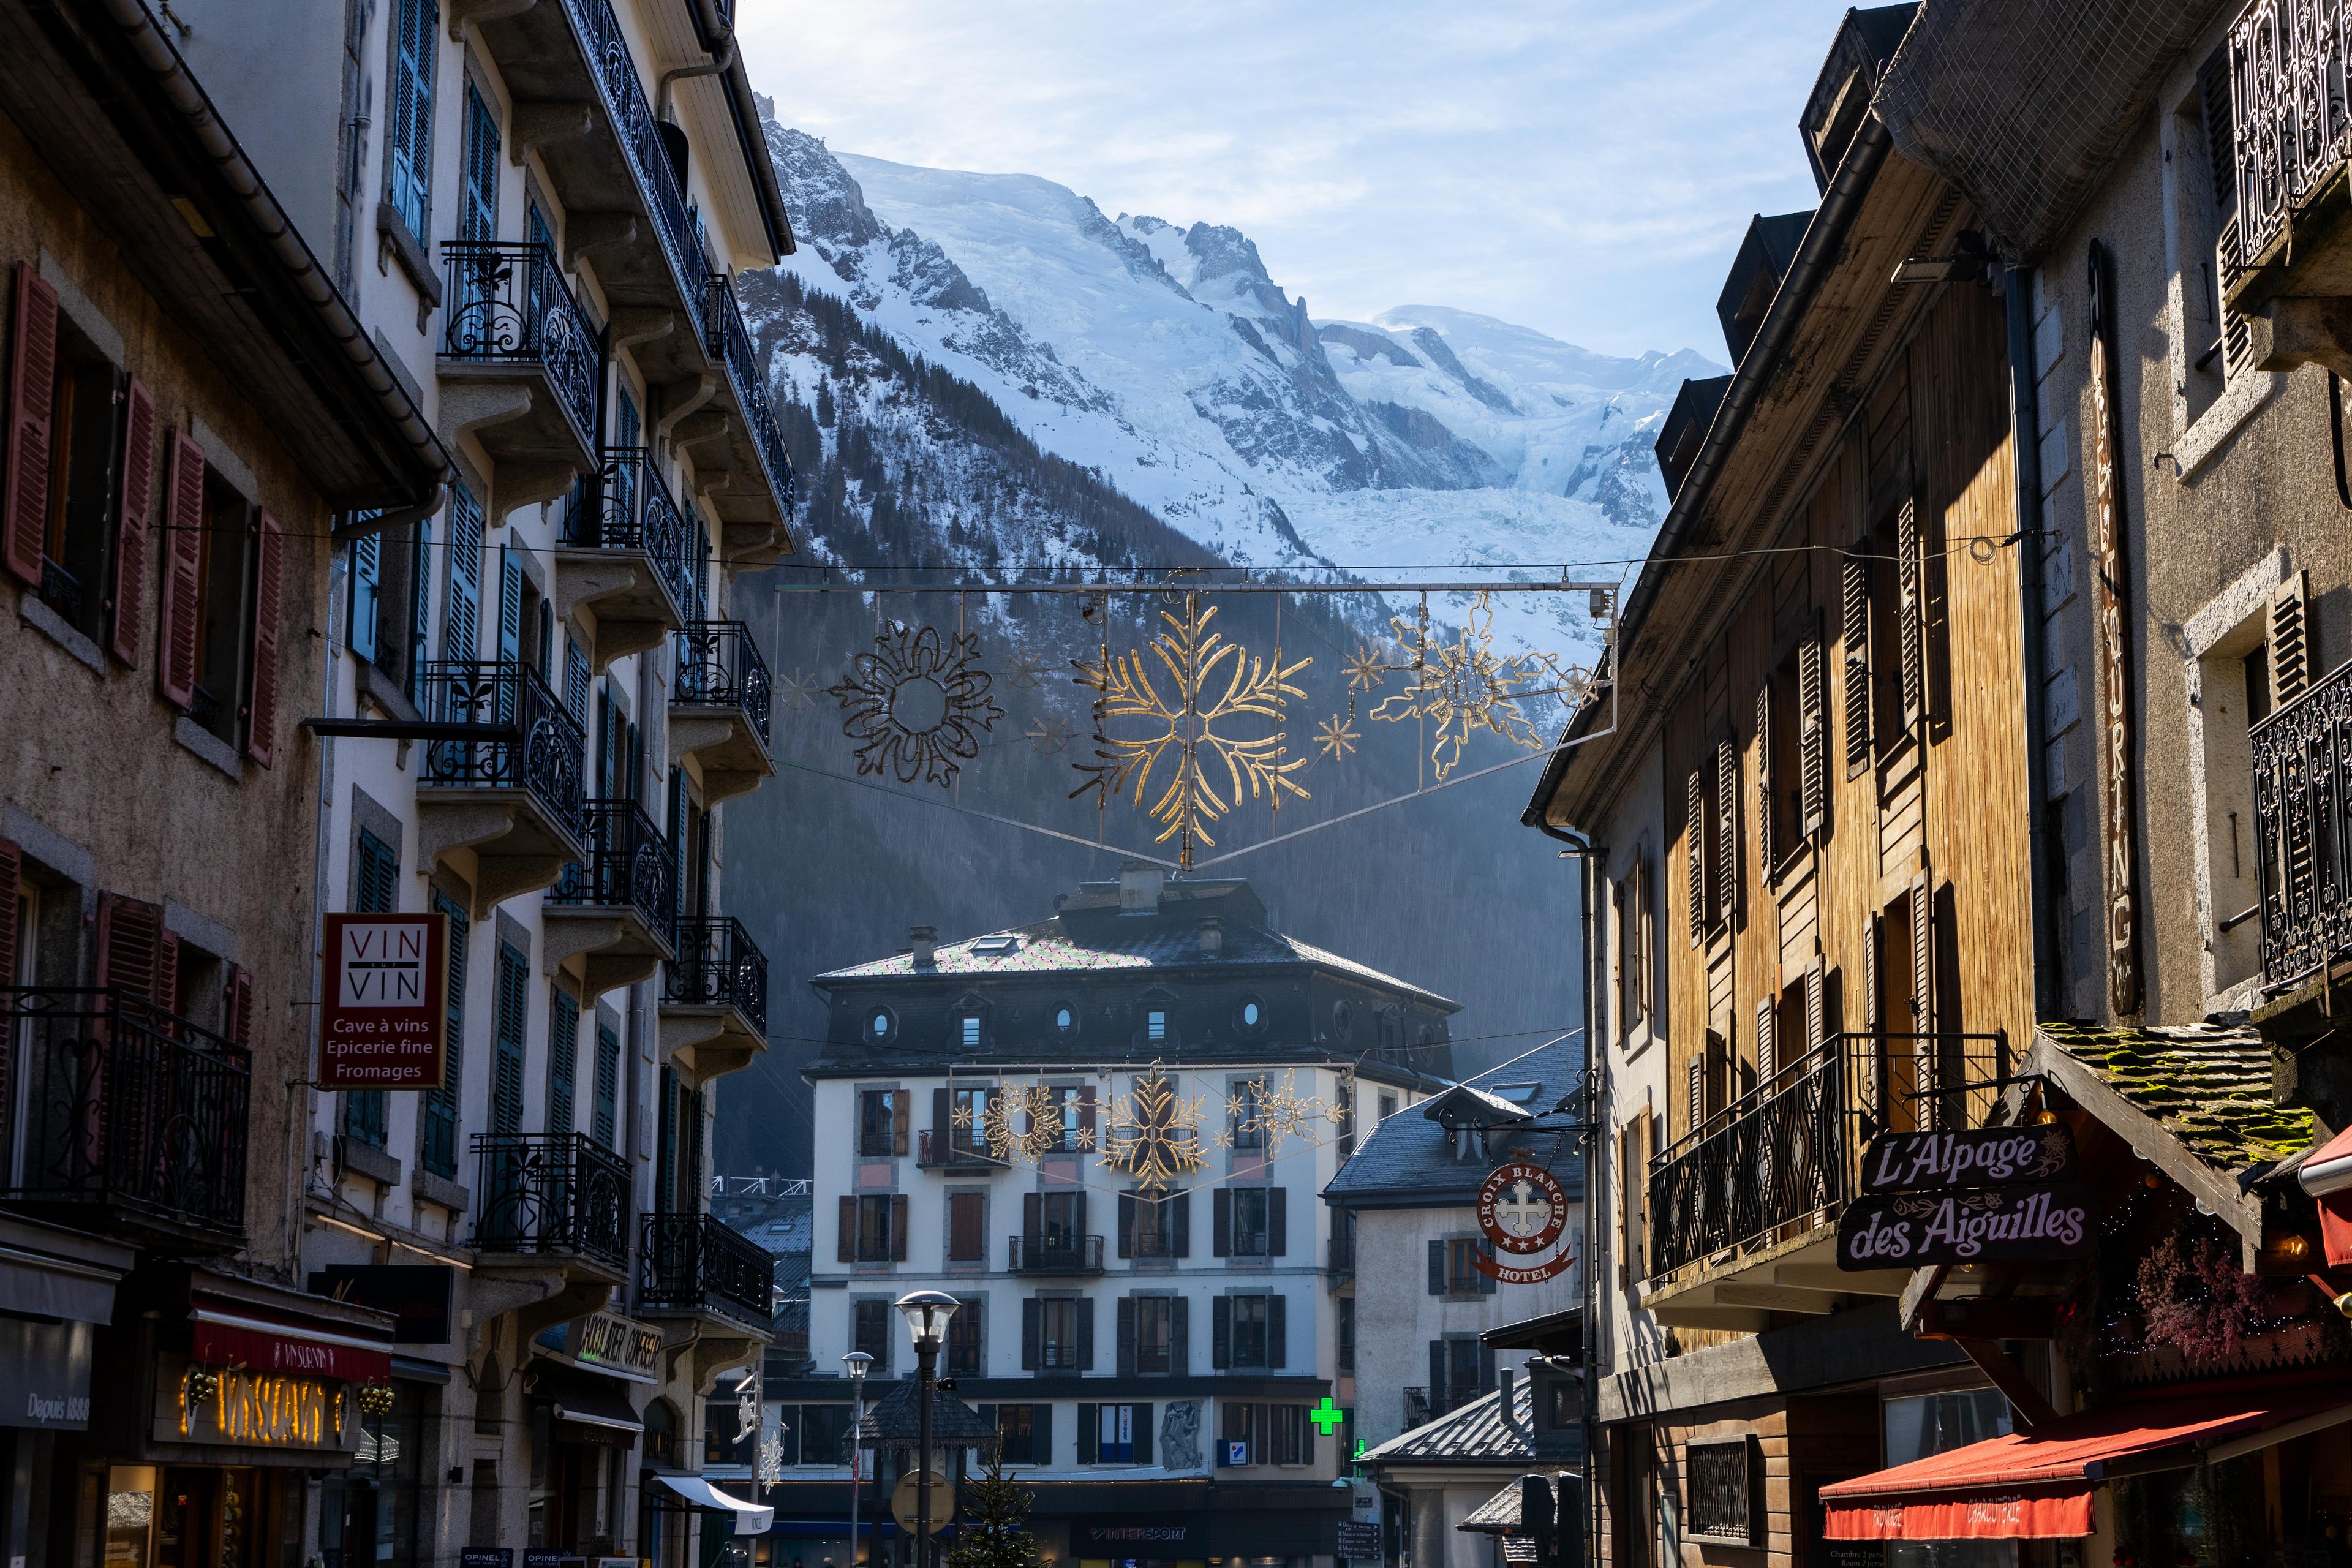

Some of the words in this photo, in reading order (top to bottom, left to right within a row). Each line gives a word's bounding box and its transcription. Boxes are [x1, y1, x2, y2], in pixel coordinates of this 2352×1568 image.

[349, 930, 421, 959] VIN
[348, 971, 419, 1000] VIN
[333, 1019, 375, 1033] Cave
[380, 1019, 389, 1033] à
[394, 1019, 429, 1033] vins
[327, 1040, 396, 1057] Epicerie
[401, 1039, 433, 1054] fine
[336, 1064, 421, 1080] Fromages
[1872, 1133, 2037, 1186] L'Alpage
[1482, 1172, 1506, 1228] CROIX
[1512, 1167, 1564, 1229] BLANCHE
[1850, 1210, 1910, 1259] des
[1917, 1192, 2086, 1257] Aiguilles
[1498, 1267, 1551, 1281] HOTEL
[27, 1393, 65, 1423] Depuis
[66, 1397, 90, 1421] 1888
[1967, 1494, 2021, 1523] CHARCUTERIE
[1105, 1527, 1186, 1540] INTERSPORT
